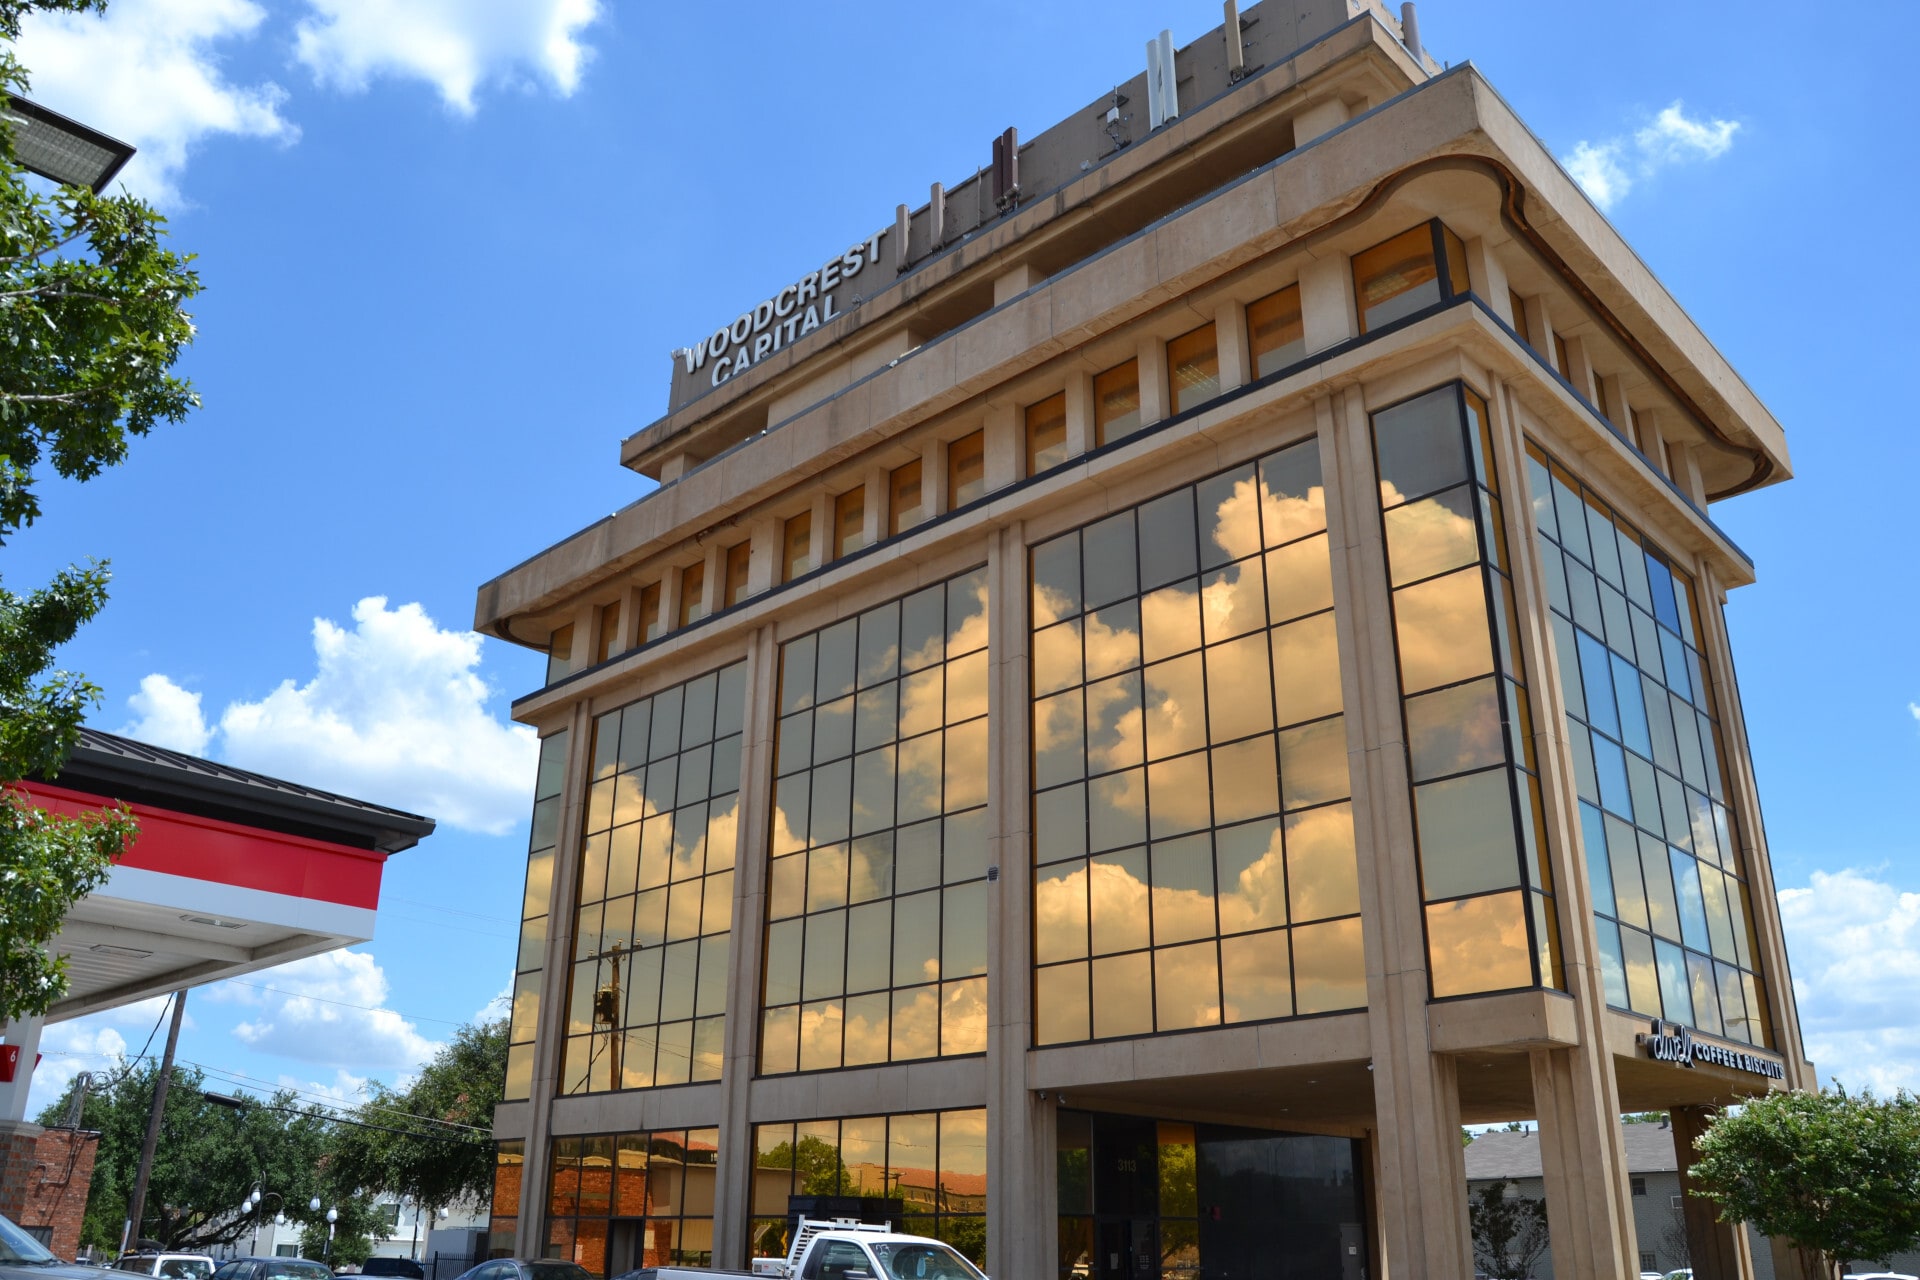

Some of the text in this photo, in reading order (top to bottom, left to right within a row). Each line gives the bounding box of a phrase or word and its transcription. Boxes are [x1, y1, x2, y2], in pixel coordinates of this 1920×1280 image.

[684, 227, 887, 374] WOODCREST
[712, 294, 840, 387] CAPITAL
[10, 1050, 16, 1063] 6
[1695, 1042, 1736, 1069] COFFEE
[1736, 1052, 1745, 1071] &
[1744, 1053, 1785, 1079] BISCUITS
[1117, 1158, 1137, 1173] 3113
